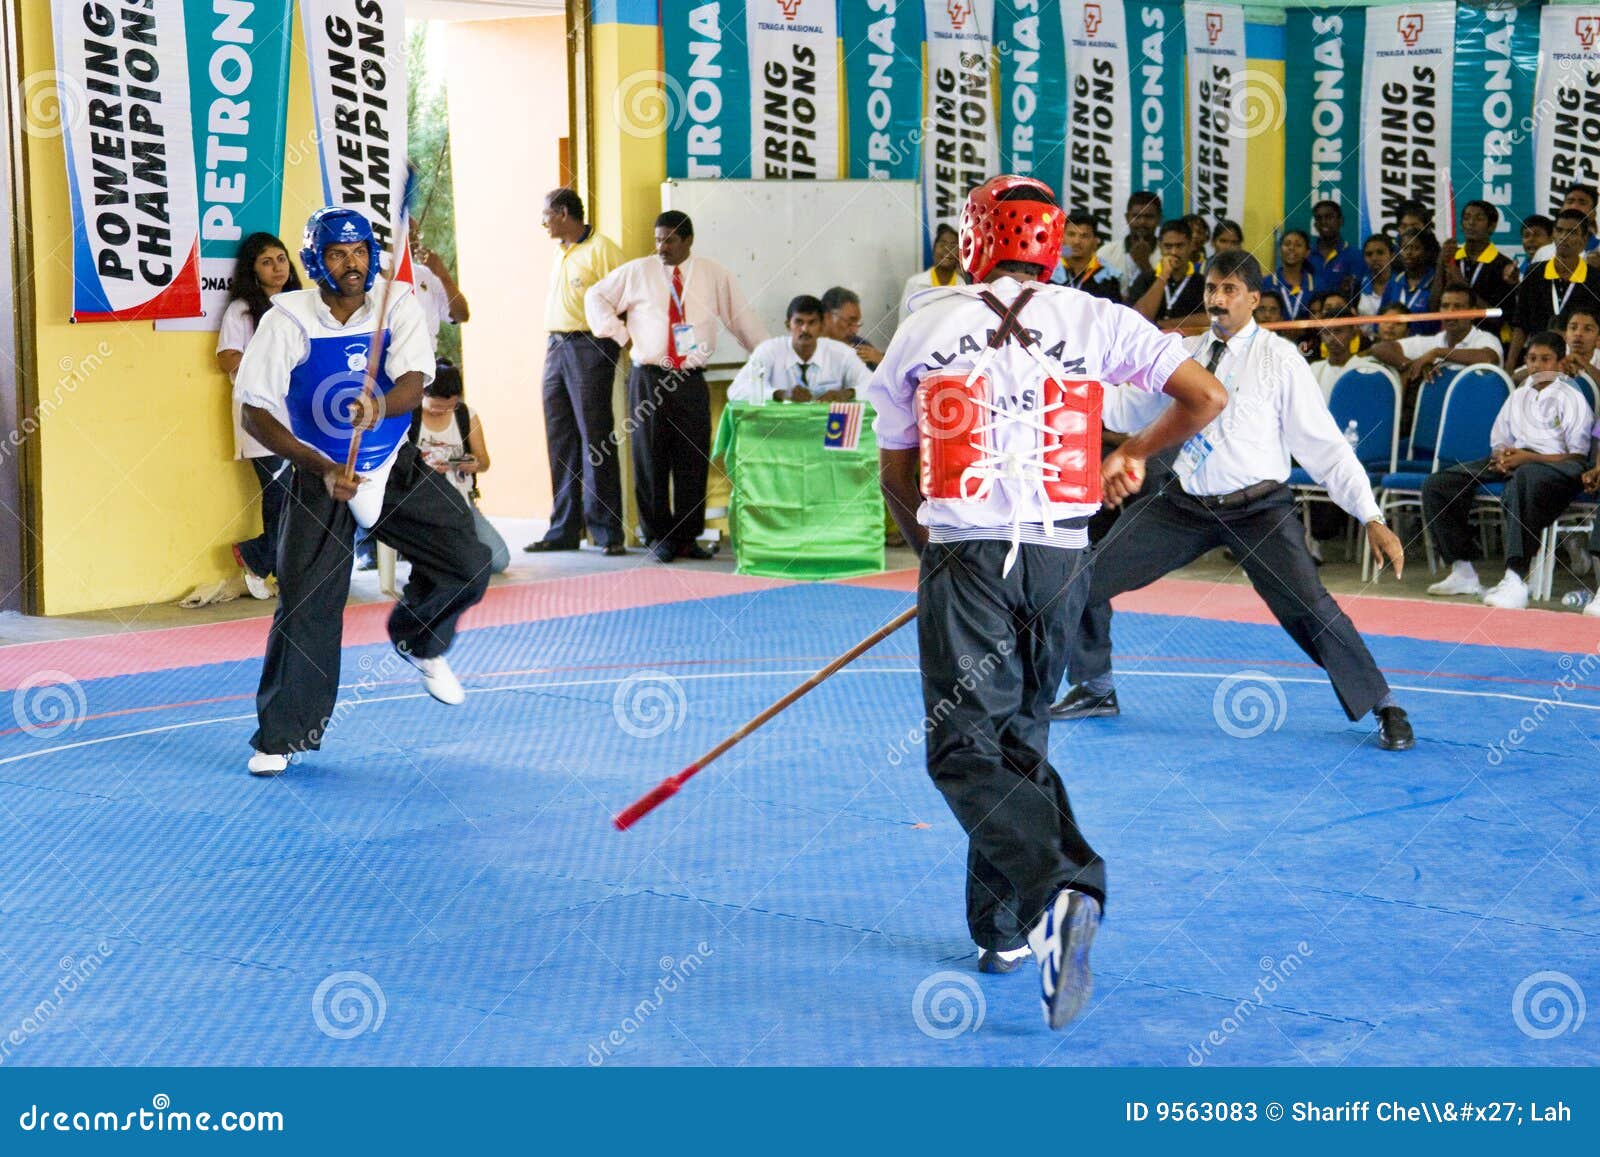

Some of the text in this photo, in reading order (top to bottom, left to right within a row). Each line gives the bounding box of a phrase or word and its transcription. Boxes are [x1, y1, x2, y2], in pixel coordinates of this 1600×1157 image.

[758, 22, 824, 34] TENAGA NASIONAL
[1376, 48, 1442, 58] TENAGA NASIONAL
[83, 2, 134, 281] POWERING
[1310, 15, 1345, 236] ETRONAS
